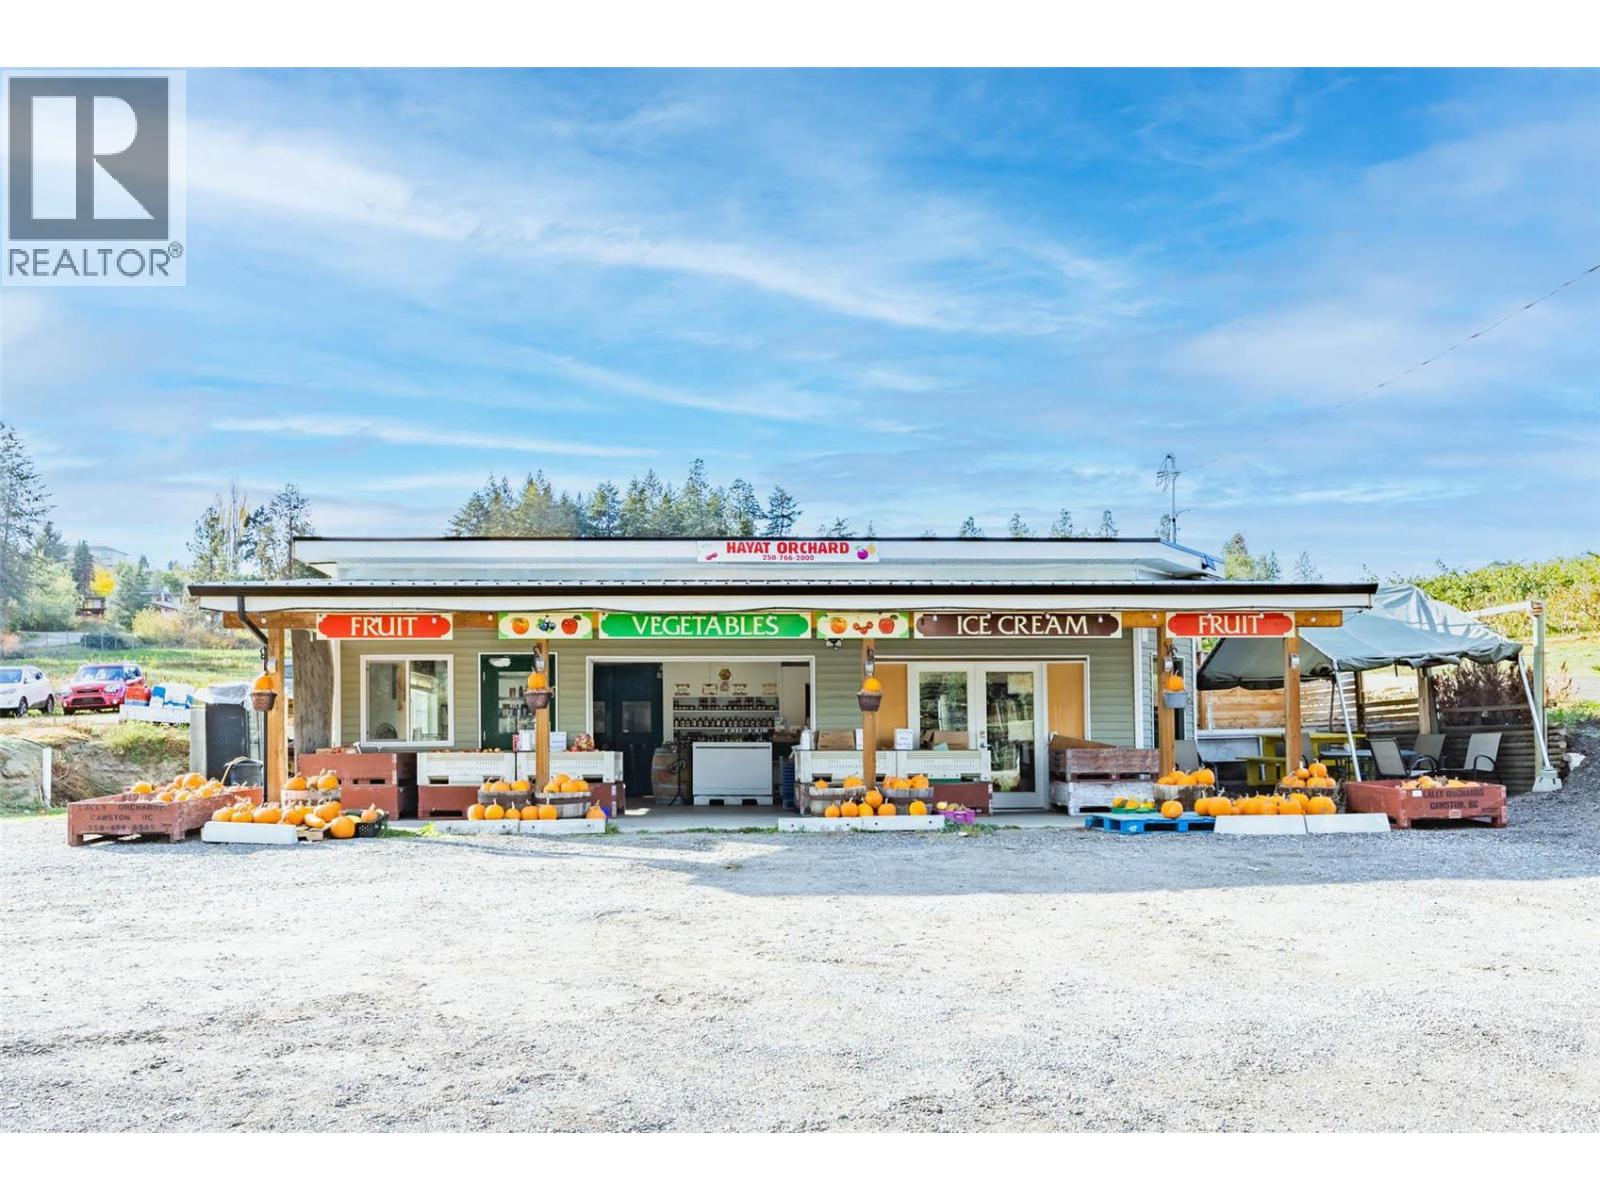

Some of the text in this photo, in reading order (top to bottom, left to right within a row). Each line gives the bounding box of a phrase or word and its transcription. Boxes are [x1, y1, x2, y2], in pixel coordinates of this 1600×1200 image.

[726, 541, 850, 555] HAYAT ORCHARD
[351, 616, 418, 637] FRUIT
[631, 615, 779, 636] VEGETABLES
[957, 615, 1089, 635] ICE CREAM
[1198, 614, 1260, 635] FRUIT
